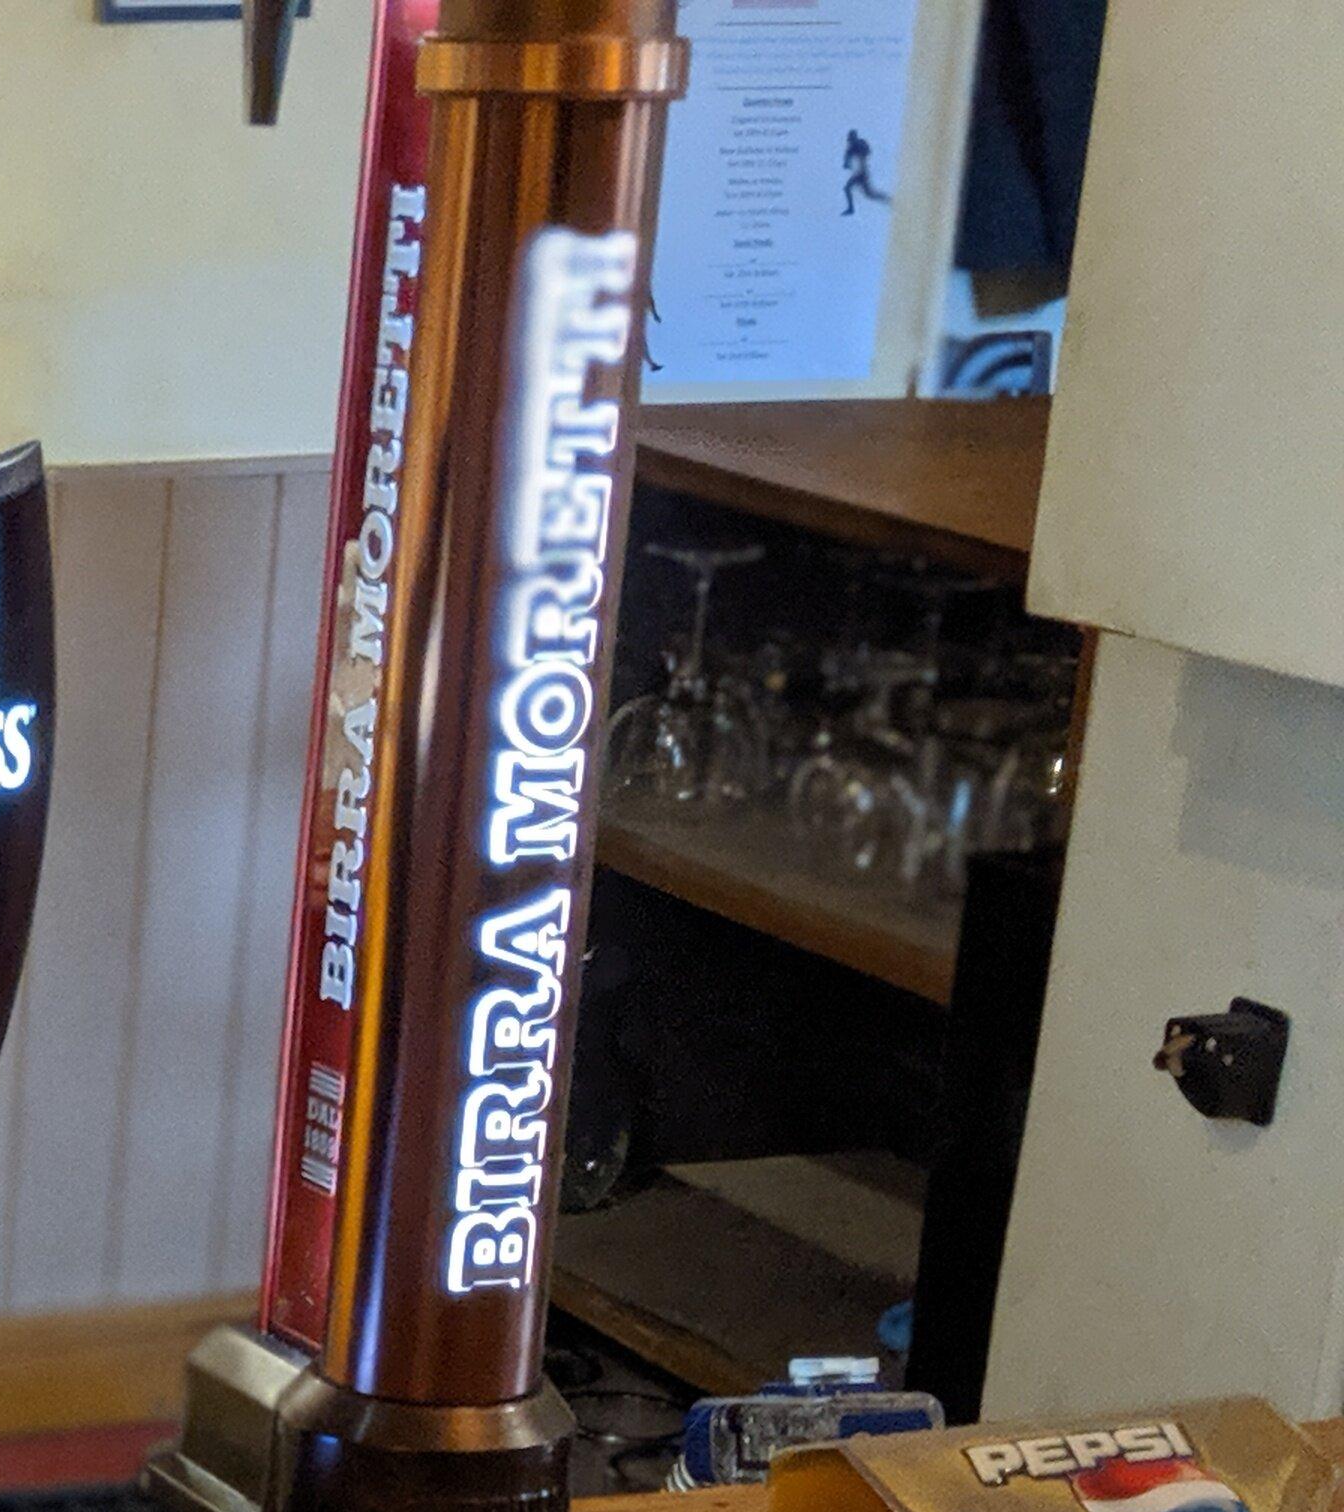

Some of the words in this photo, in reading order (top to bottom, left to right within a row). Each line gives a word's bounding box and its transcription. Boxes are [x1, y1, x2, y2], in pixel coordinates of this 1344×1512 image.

[348, 183, 427, 667] MORETTI
[488, 226, 638, 865] MORETTI
[319, 697, 378, 1012] BIRRA
[446, 888, 572, 1292] BIRRA
[962, 1420, 1196, 1487] PEPSI
